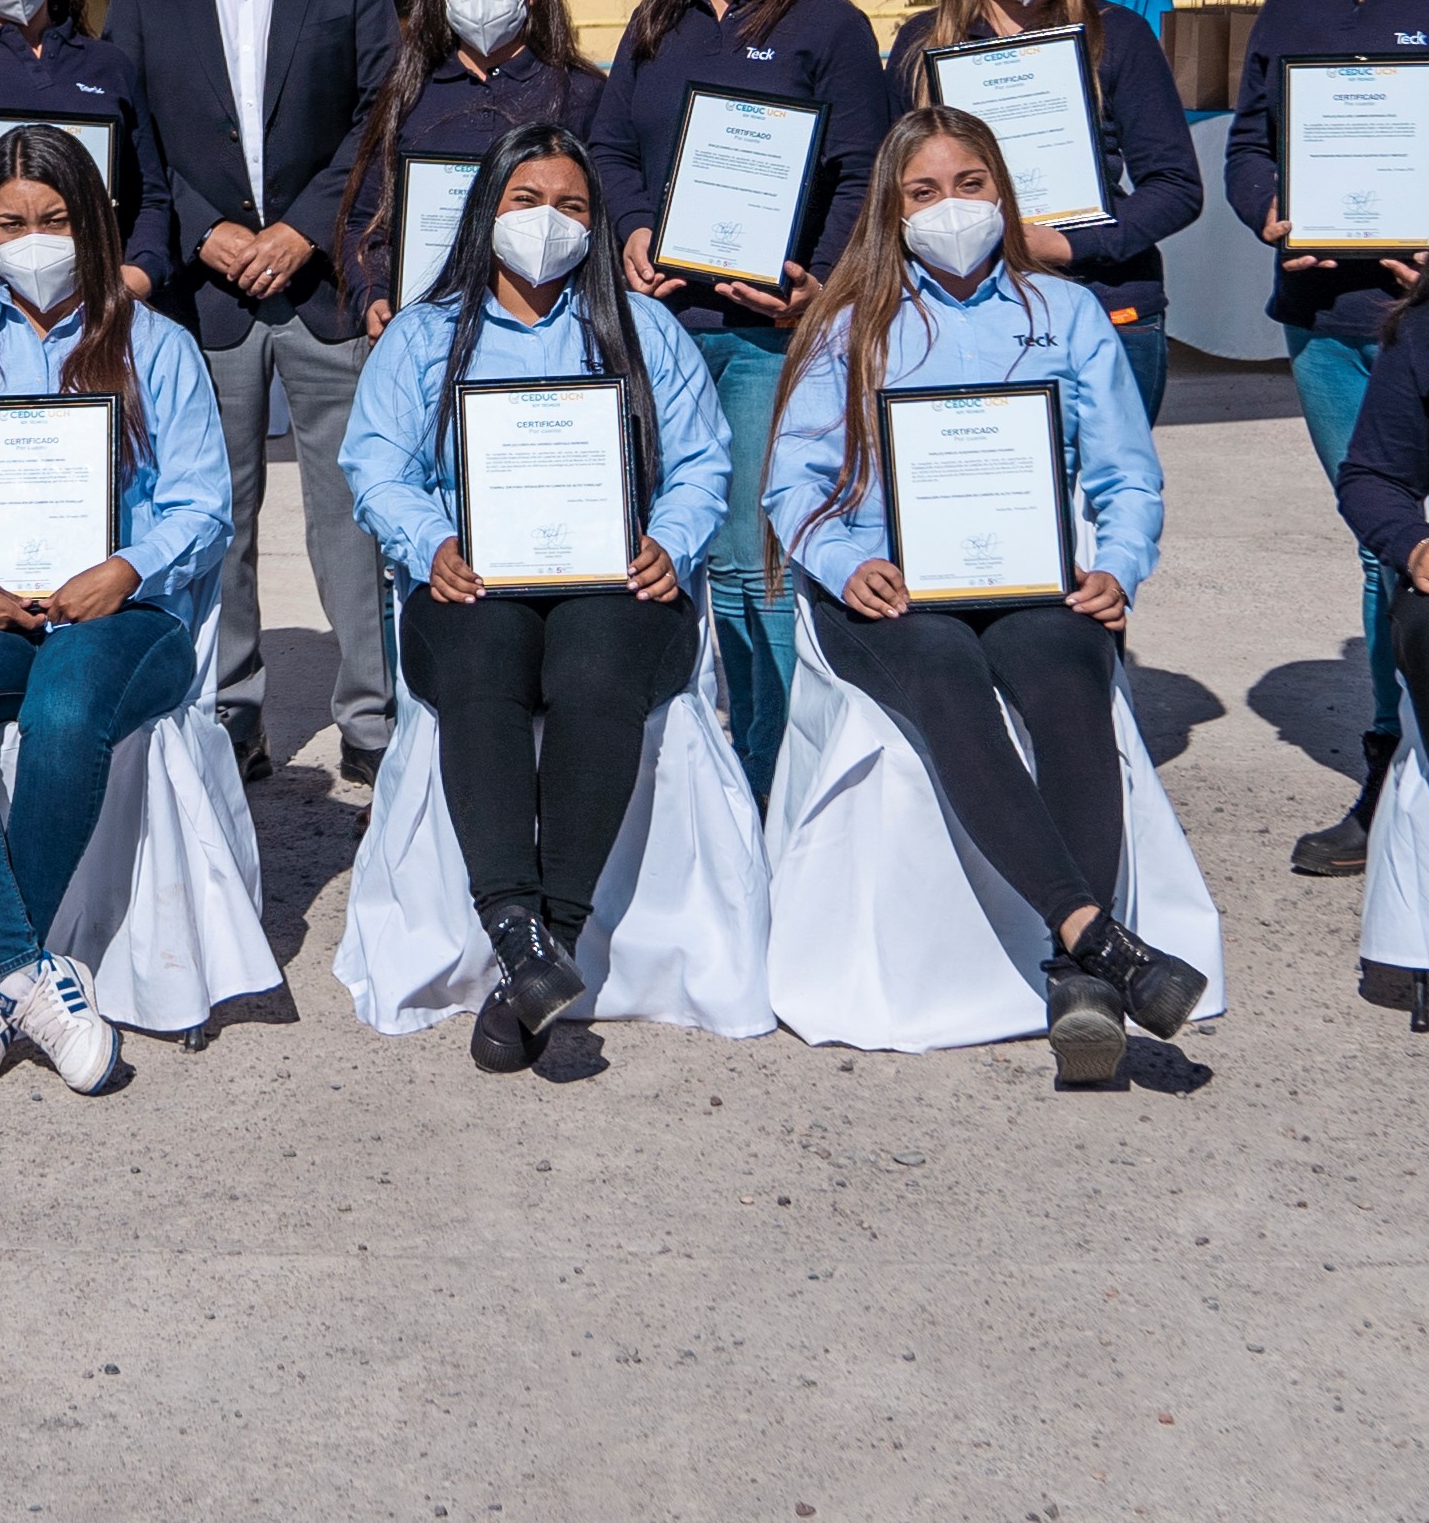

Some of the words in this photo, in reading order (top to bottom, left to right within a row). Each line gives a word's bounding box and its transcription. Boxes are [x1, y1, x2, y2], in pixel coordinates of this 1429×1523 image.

[1393, 31, 1428, 45] Teck
[746, 47, 776, 60] Teck
[984, 51, 1017, 62] CEDUC
[983, 73, 1034, 87] CERTIFICADO
[736, 103, 765, 115] CEDUC
[767, 108, 787, 118] UCN
[726, 127, 771, 140] CERTIFICADO
[1012, 332, 1059, 348] Teck
[521, 393, 558, 402] CEDUC
[560, 392, 583, 400] UCN
[517, 420, 573, 428] CERTIFICADO
[941, 427, 999, 436] CERTIFICADO
[5, 437, 59, 445] CERTIFICADO
